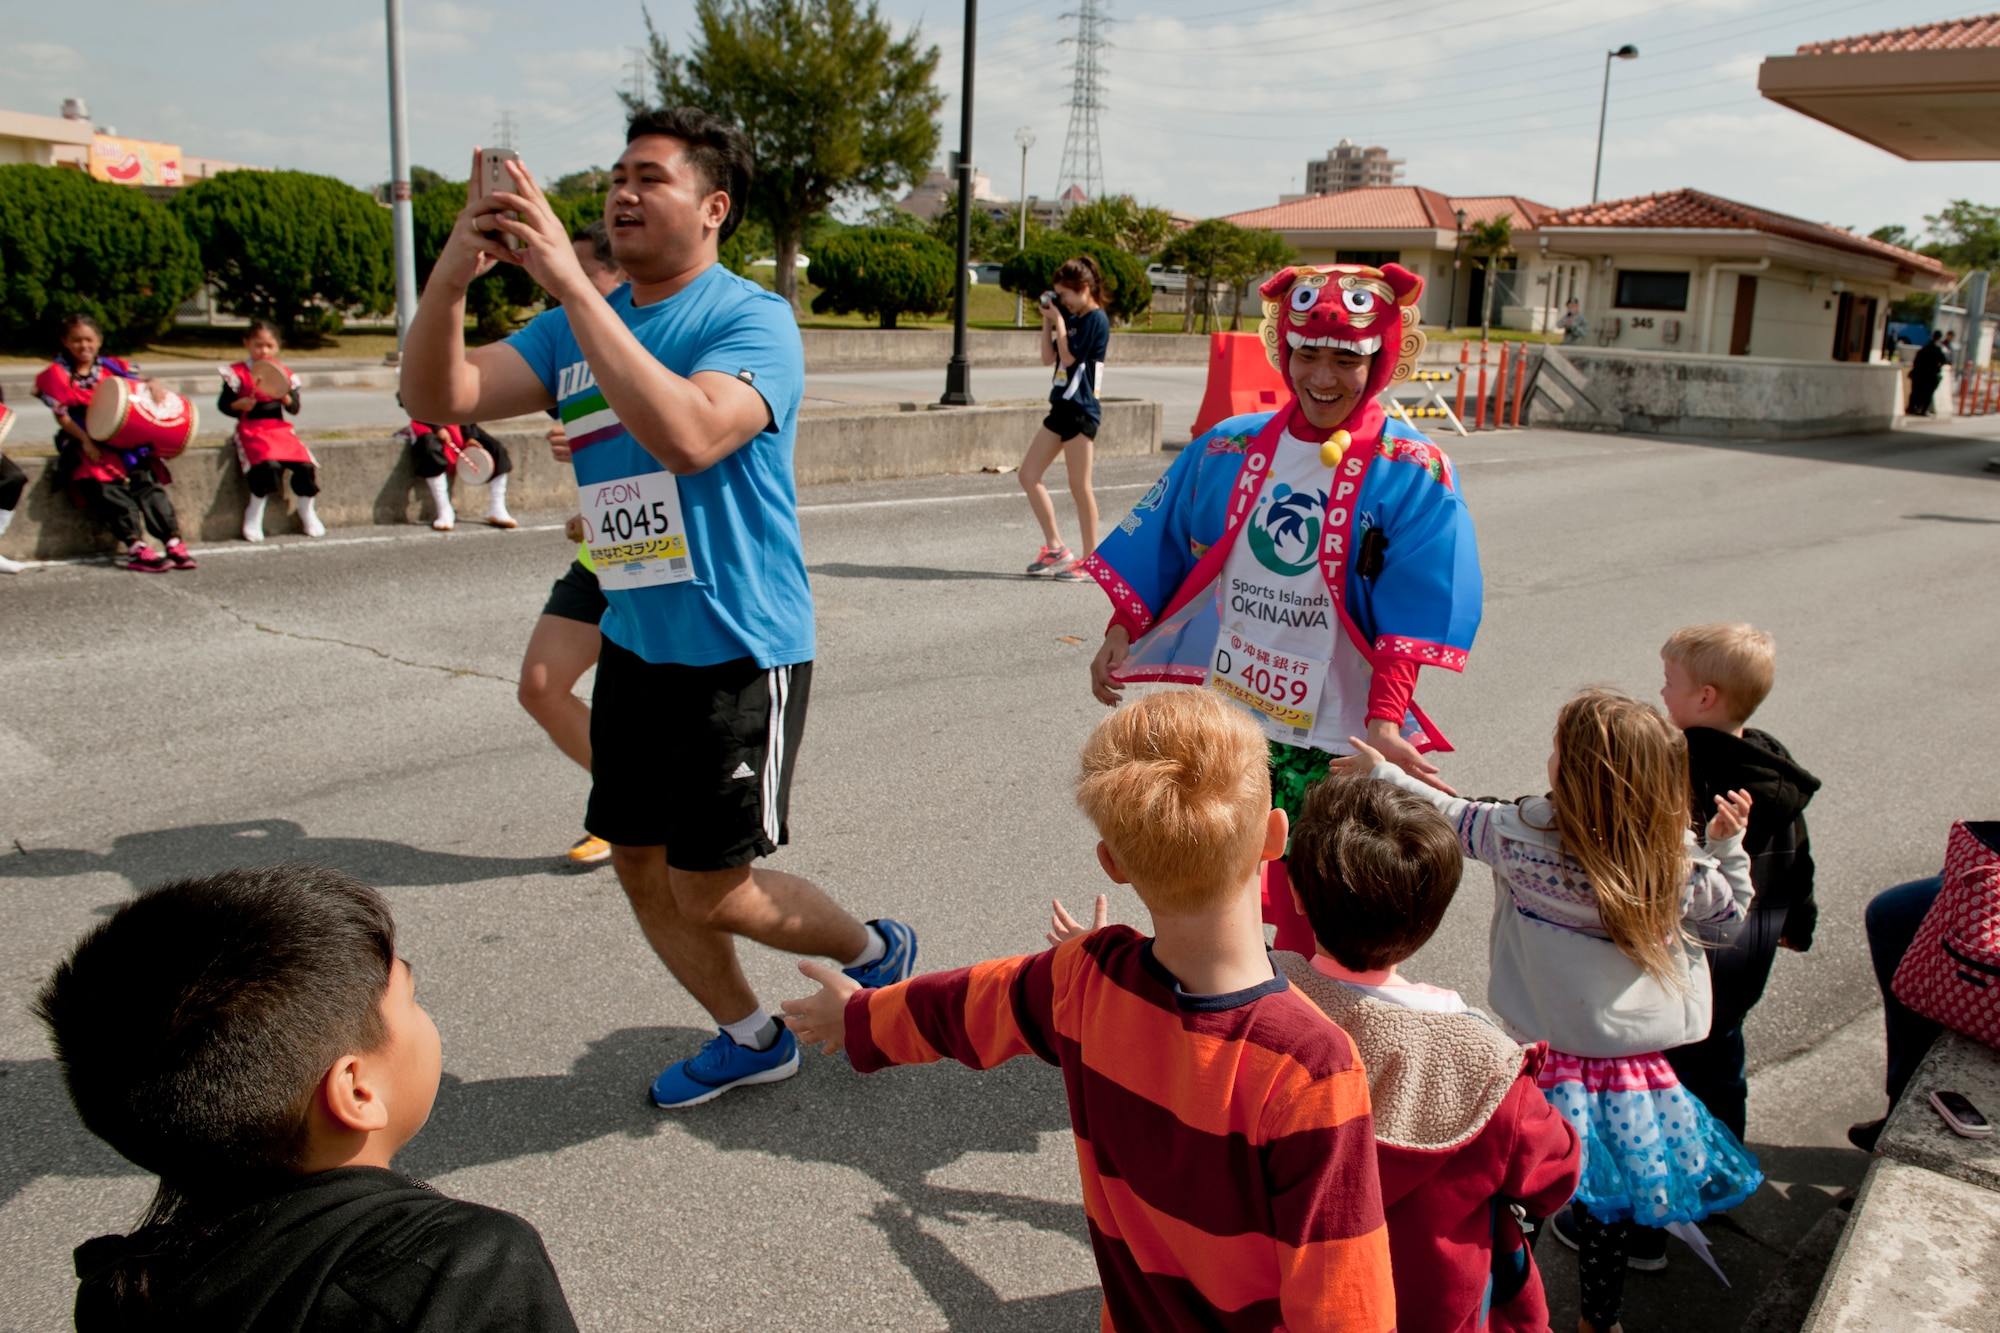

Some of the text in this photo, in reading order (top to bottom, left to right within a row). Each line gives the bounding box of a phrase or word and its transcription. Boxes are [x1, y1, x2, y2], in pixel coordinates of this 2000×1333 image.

[1631, 316, 1654, 329] 345
[601, 501, 669, 542] 4045
[1232, 578, 1330, 607] Sports Islands
[1231, 595, 1329, 630] OKINAWA
[1216, 649, 1308, 706] D 4059
